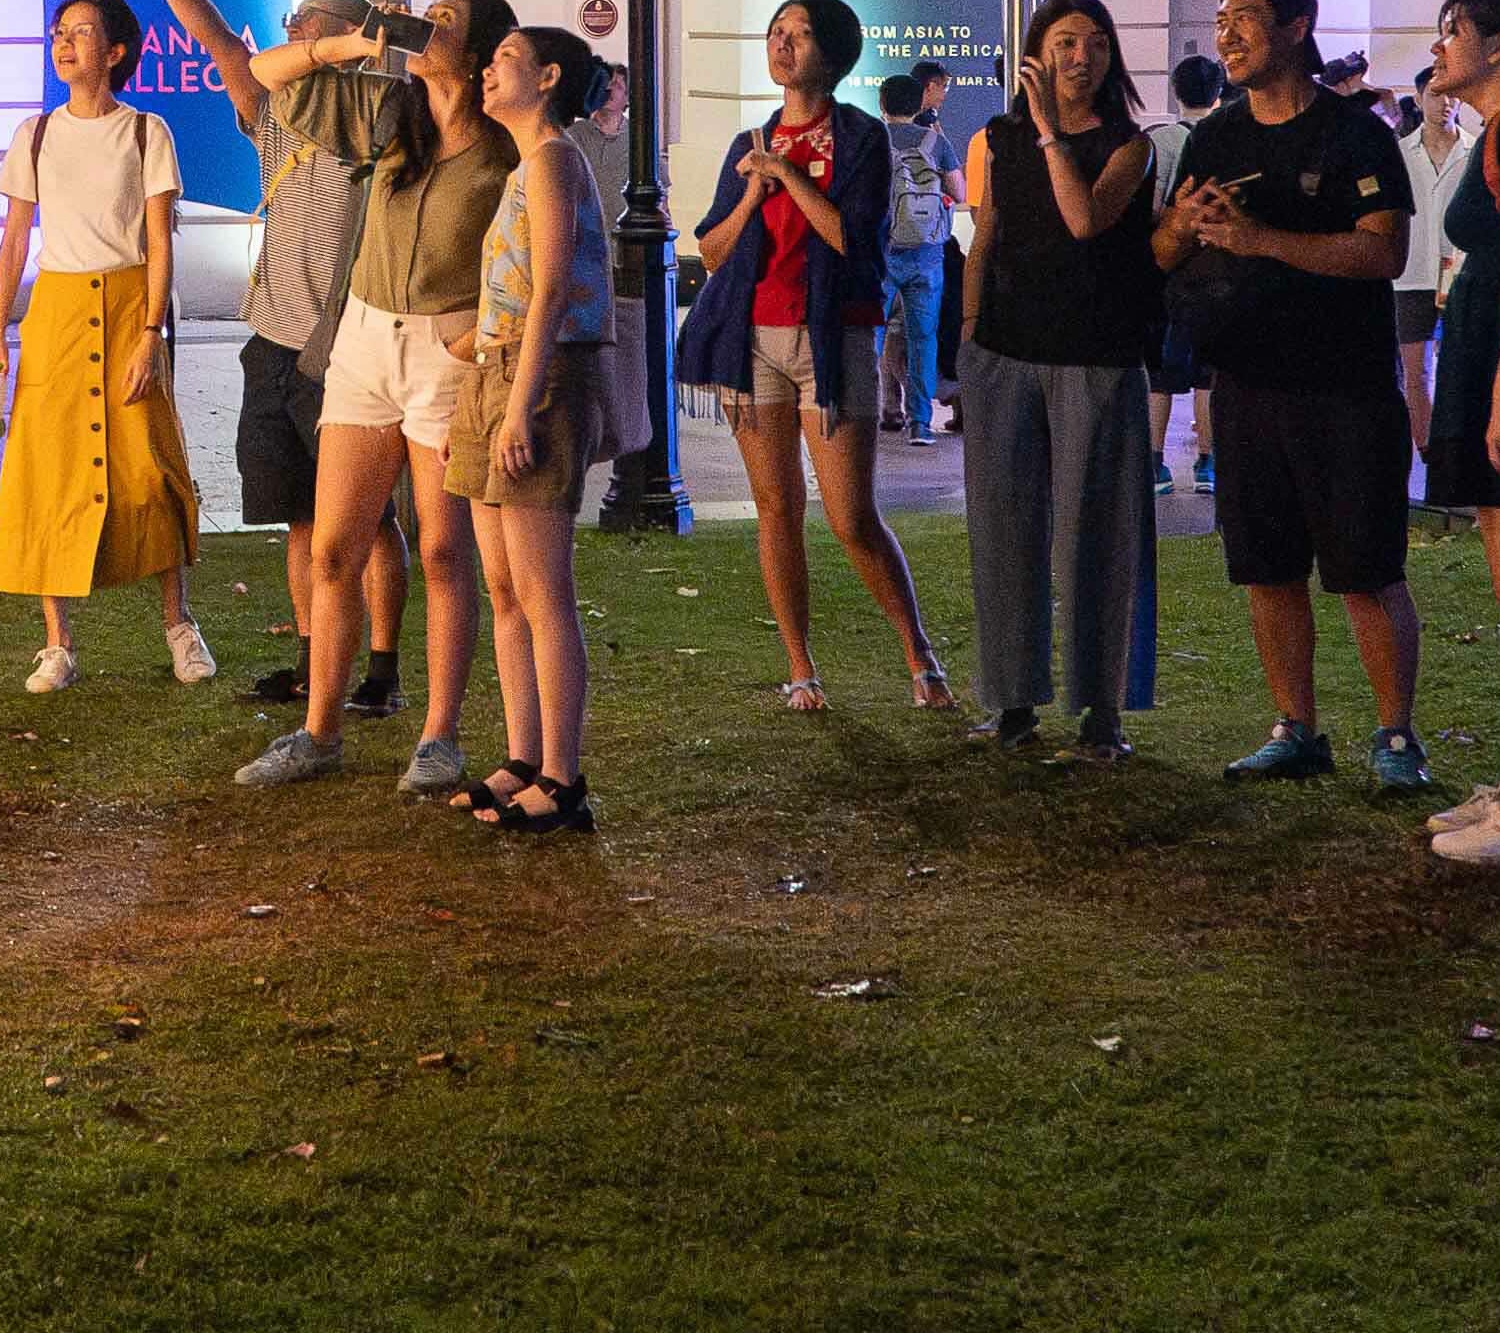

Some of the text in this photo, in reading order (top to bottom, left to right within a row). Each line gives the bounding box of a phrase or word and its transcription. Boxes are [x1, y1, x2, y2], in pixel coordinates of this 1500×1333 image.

[860, 25, 971, 39] ROM ASIA TO
[876, 44, 1004, 57] THE AMERICA
[956, 76, 983, 86] MAR
